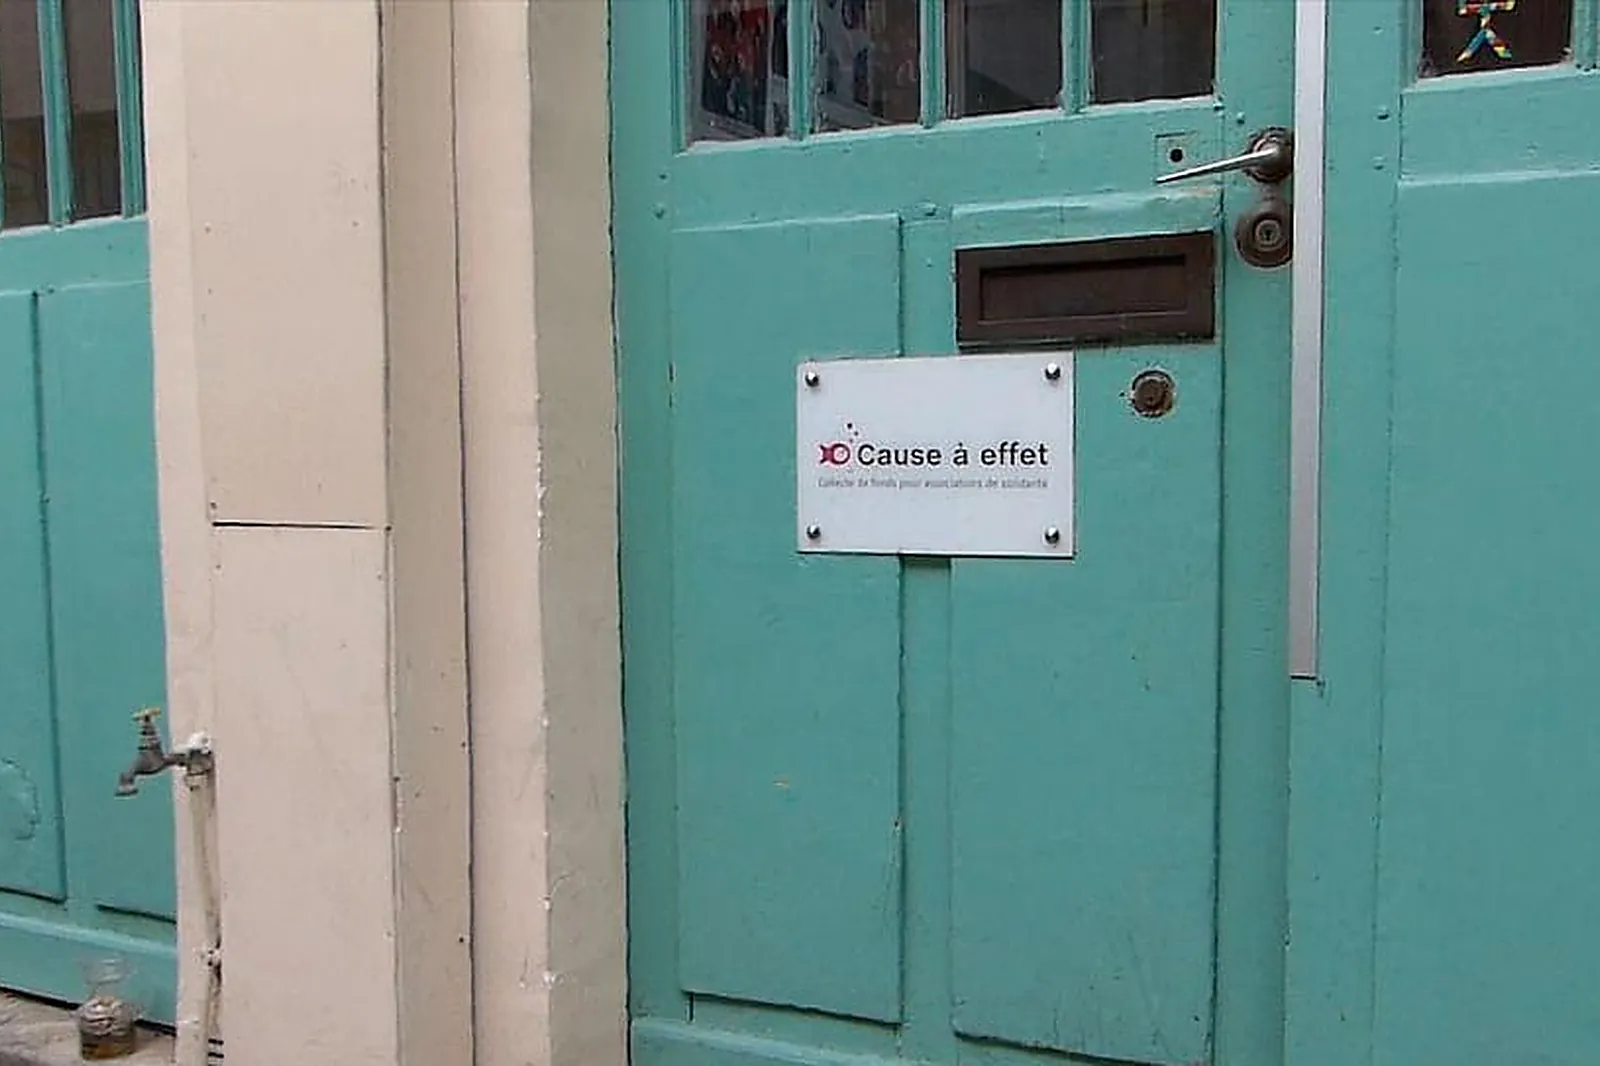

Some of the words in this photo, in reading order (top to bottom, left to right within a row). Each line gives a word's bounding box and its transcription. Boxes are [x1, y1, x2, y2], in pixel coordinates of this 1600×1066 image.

[857, 443, 942, 466] Cause
[953, 441, 969, 466] à
[980, 441, 1048, 466] effet
